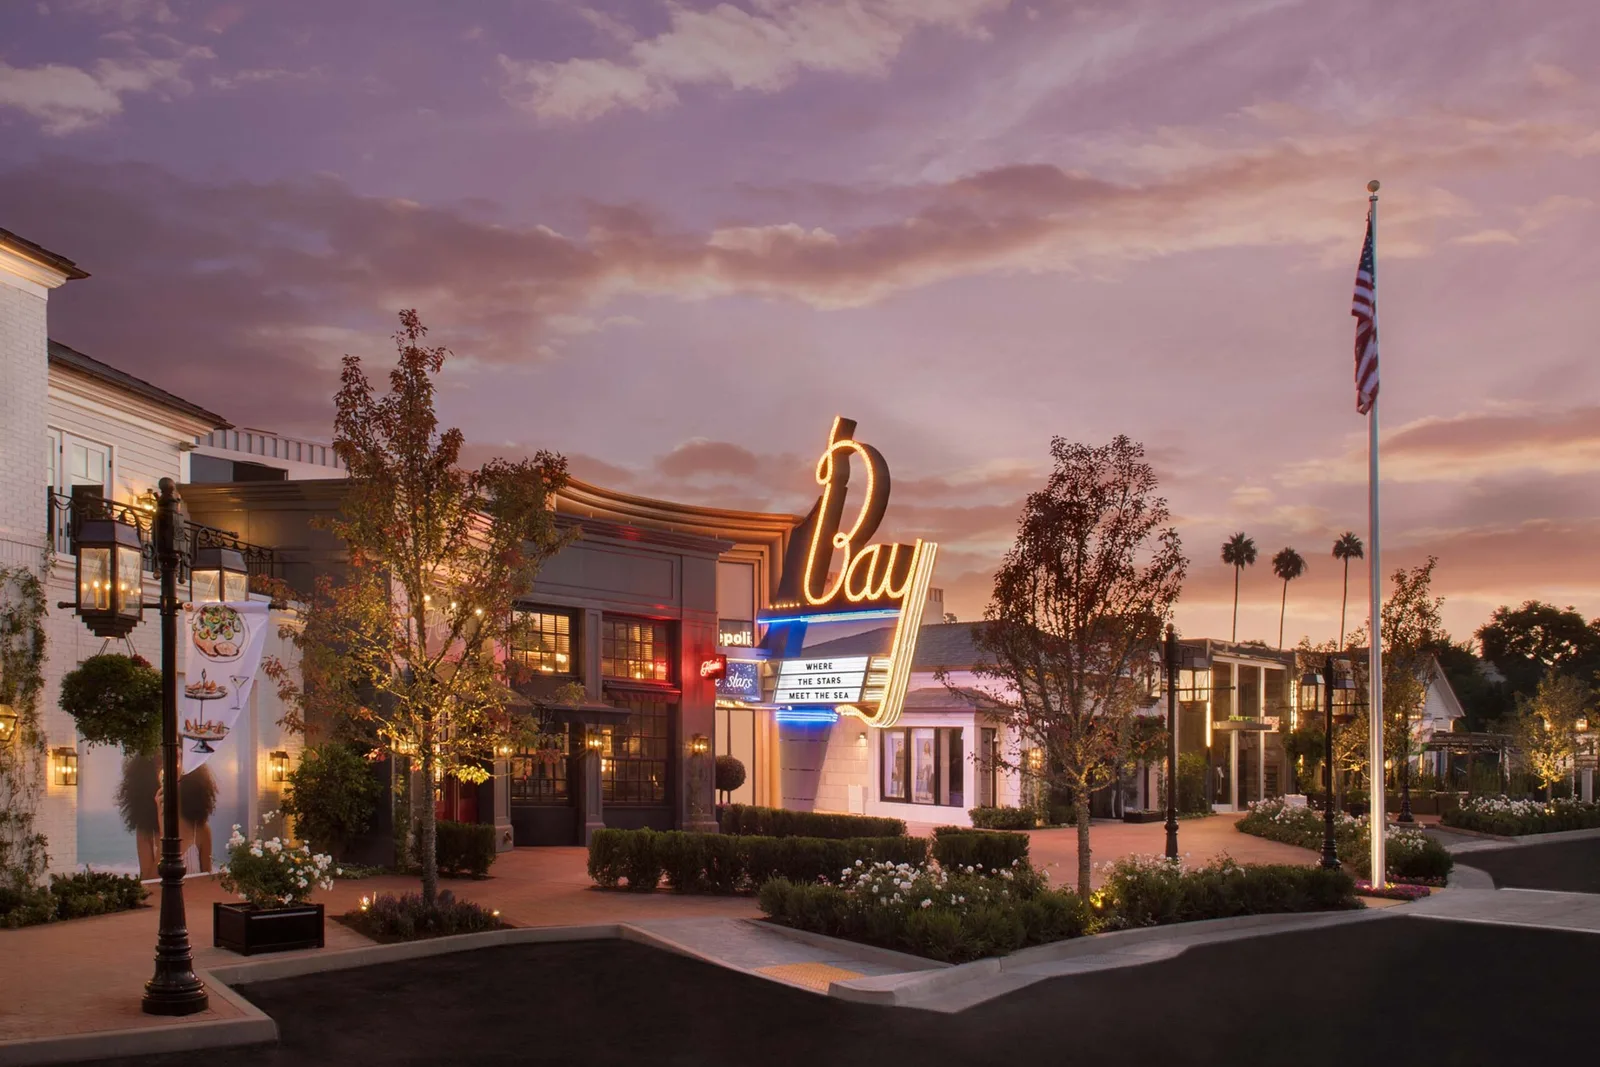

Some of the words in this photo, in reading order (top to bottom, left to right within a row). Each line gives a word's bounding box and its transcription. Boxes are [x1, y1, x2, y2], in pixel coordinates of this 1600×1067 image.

[804, 414, 938, 728] Bay
[719, 629, 753, 648] poli
[805, 662, 833, 671] WHERE
[798, 677, 813, 686] THE
[816, 676, 842, 685] STARS
[788, 692, 811, 700] MEET
[814, 691, 830, 699] THE
[833, 691, 849, 699] SEA
